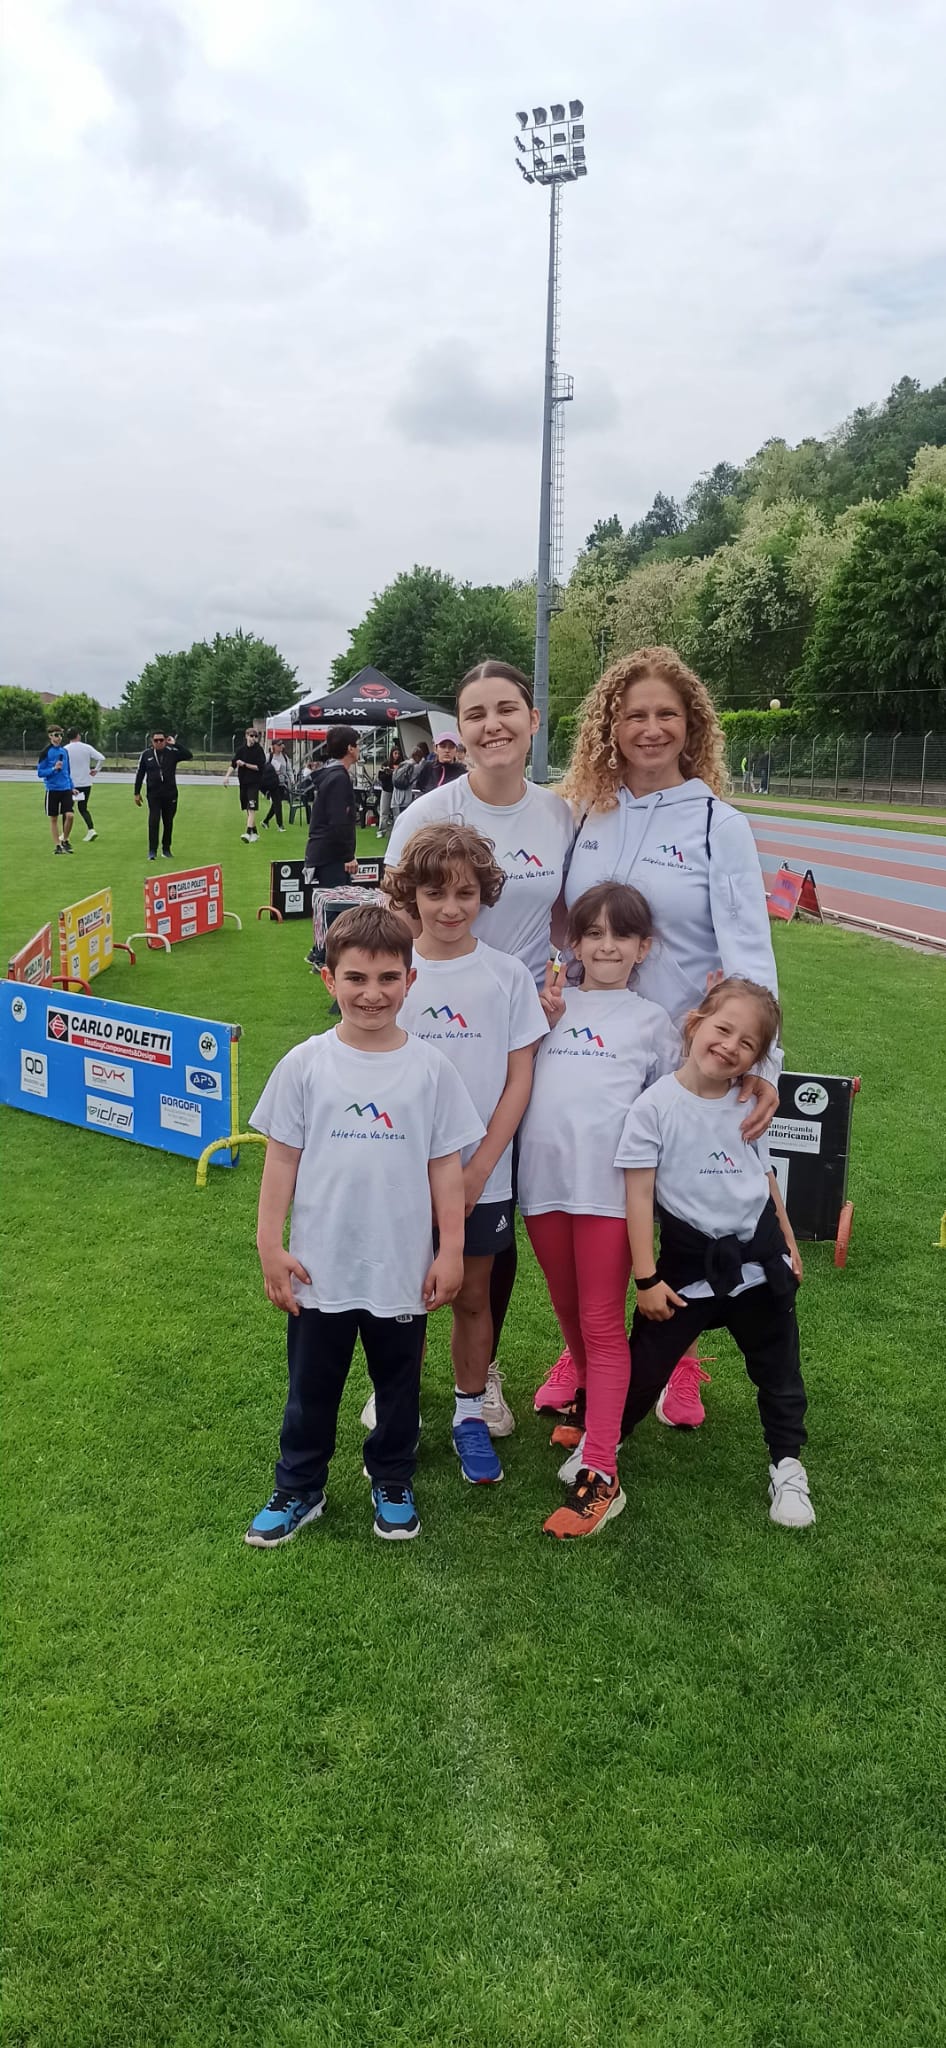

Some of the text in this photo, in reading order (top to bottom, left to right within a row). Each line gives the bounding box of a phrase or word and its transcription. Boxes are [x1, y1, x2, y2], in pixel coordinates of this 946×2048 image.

[323, 708, 367, 717] 24MX
[358, 866, 377, 874] LETTI
[505, 870, 555, 880] etica Valsesia
[177, 881, 190, 891] CARLO
[71, 1017, 171, 1051] CARLO POLETTI
[445, 1030, 482, 1039] Valsesia
[83, 1037, 157, 1062] HeatingComponents&Design
[201, 1040, 213, 1051] CR
[548, 1048, 617, 1059] Atletica Valsesia
[25, 1056, 44, 1075] QD
[91, 1064, 125, 1082] DVK
[193, 1073, 214, 1087] APS
[161, 1095, 201, 1113] BORGOFIL
[798, 1091, 819, 1104] CR
[97, 1103, 134, 1127] idral
[330, 1129, 406, 1140] Atletica Valsesia
[768, 1129, 818, 1142] ttoricambi
